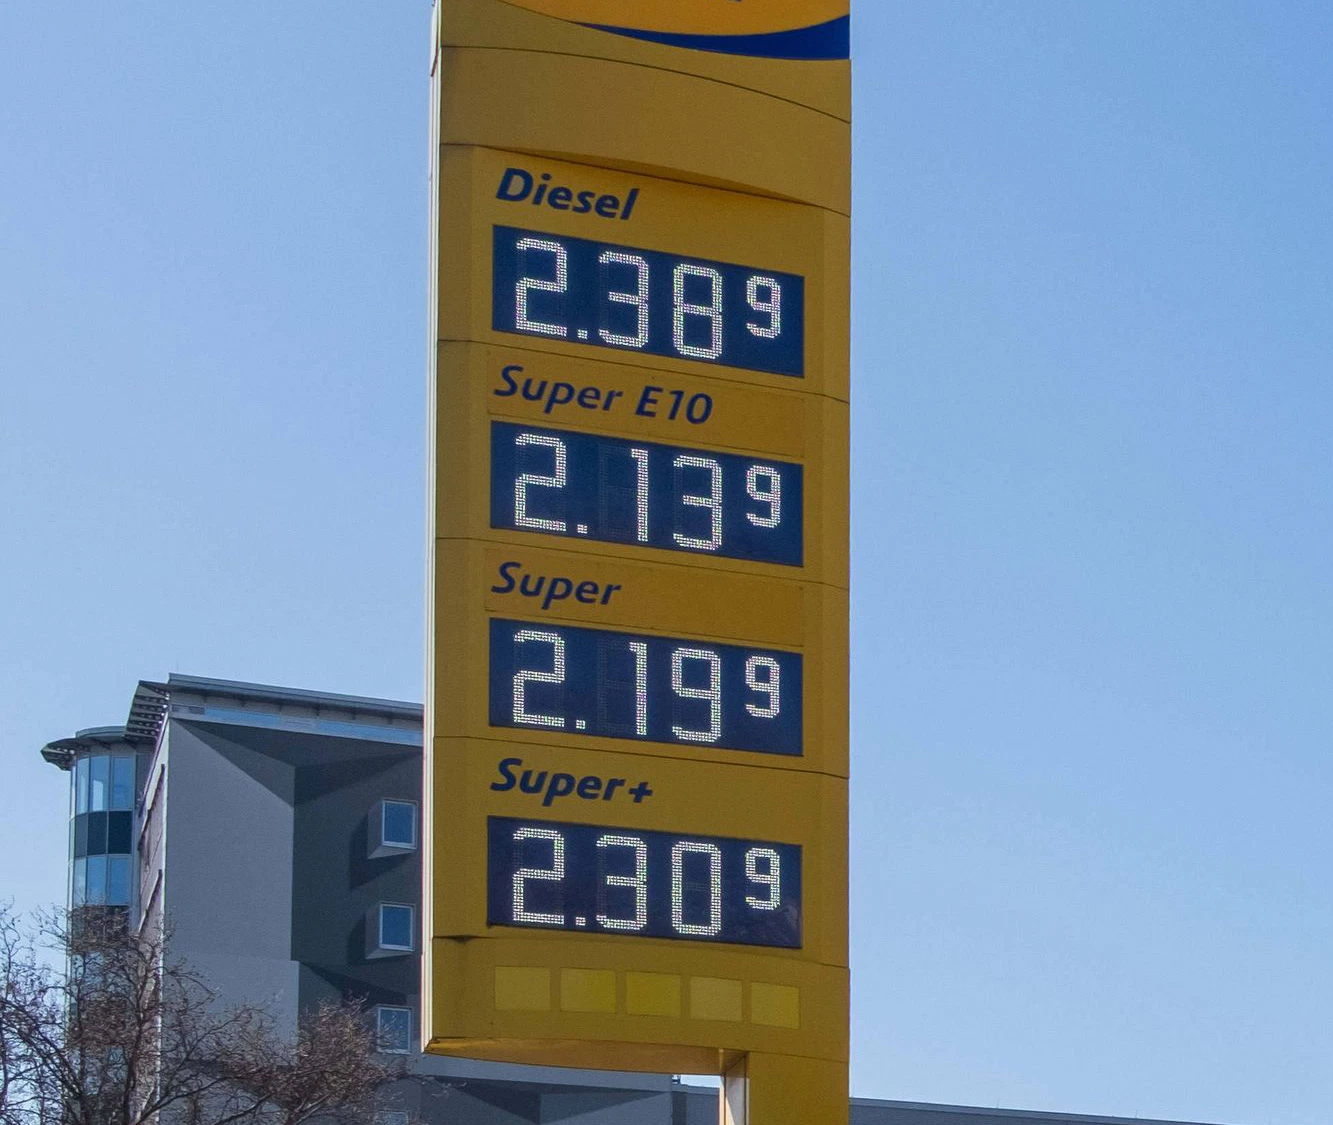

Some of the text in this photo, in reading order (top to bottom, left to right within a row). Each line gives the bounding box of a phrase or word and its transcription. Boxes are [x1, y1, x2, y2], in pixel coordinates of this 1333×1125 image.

[495, 168, 640, 221] Diesel
[515, 237, 781, 359] 2.389
[493, 365, 714, 425] Super E10
[515, 433, 781, 550] 2.139
[490, 562, 622, 610] Super
[512, 630, 781, 742] 2.199
[540, 642, 781, 765] JET
[512, 827, 780, 936] 2.309
